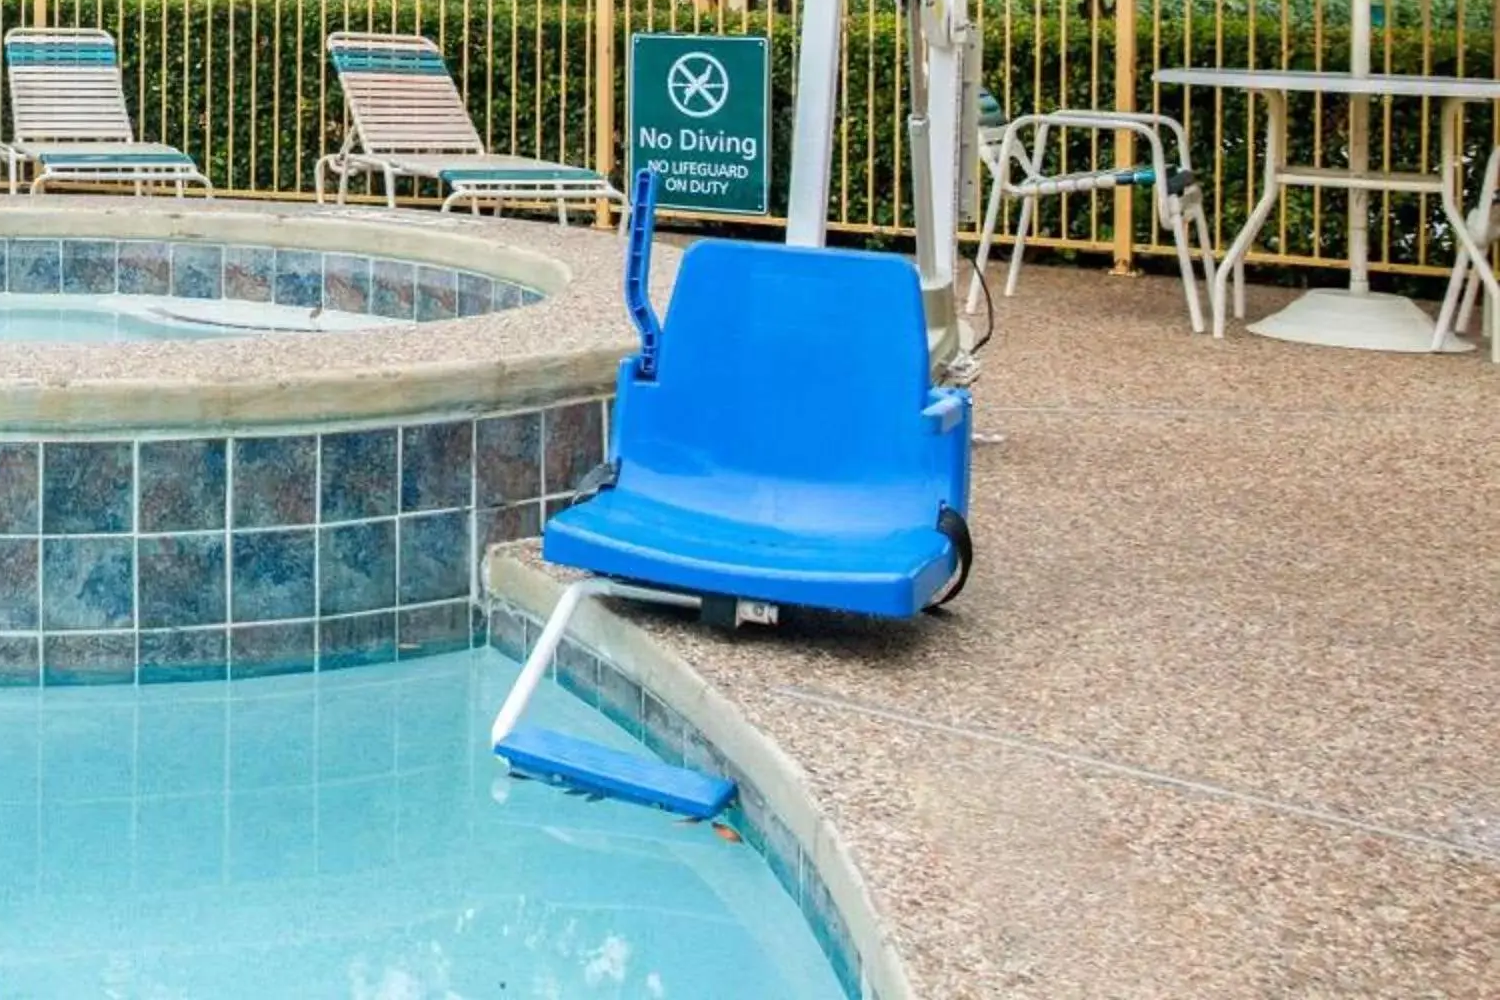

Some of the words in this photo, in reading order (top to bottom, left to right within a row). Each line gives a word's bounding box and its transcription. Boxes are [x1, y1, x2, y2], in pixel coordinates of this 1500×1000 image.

[639, 126, 672, 150] No
[680, 128, 757, 161] Diving
[647, 160, 669, 174] NO
[671, 161, 749, 179] LIFEGUARD
[665, 178, 687, 192] ON
[690, 180, 729, 194] DUTY
